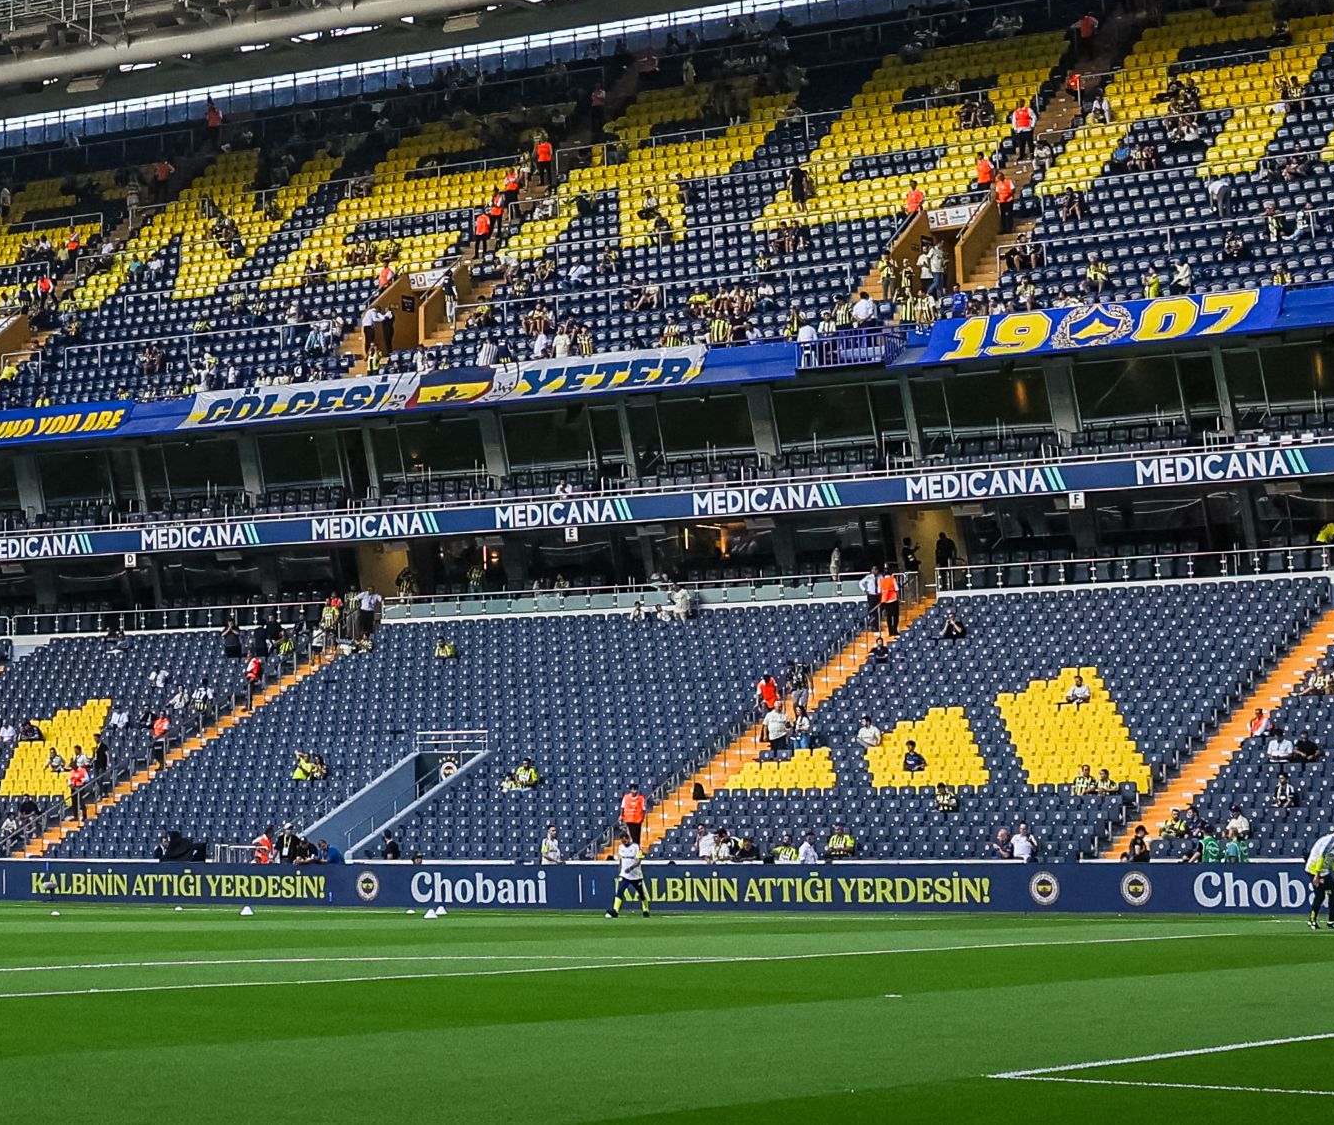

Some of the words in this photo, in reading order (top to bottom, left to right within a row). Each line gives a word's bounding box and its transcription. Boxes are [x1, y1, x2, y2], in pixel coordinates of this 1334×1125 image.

[519, 358, 701, 397] YETER
[31, 415, 80, 436] YOU
[80, 409, 125, 431] ARE
[141, 523, 247, 550] MEDICANA
[312, 511, 425, 541] MEDICANA
[495, 498, 618, 529] MEDICANA
[693, 484, 827, 516] MEDICANA
[906, 467, 1048, 501] MEDICANA
[1136, 450, 1290, 485] MEDICANA
[31, 867, 128, 896] KALBİNİN
[132, 868, 202, 896] ATTIĞI
[206, 869, 326, 899] YERDESİN!
[410, 869, 547, 905] Chobani
[744, 871, 833, 903] ATTIĞI
[838, 870, 991, 903] YERDESİN!
